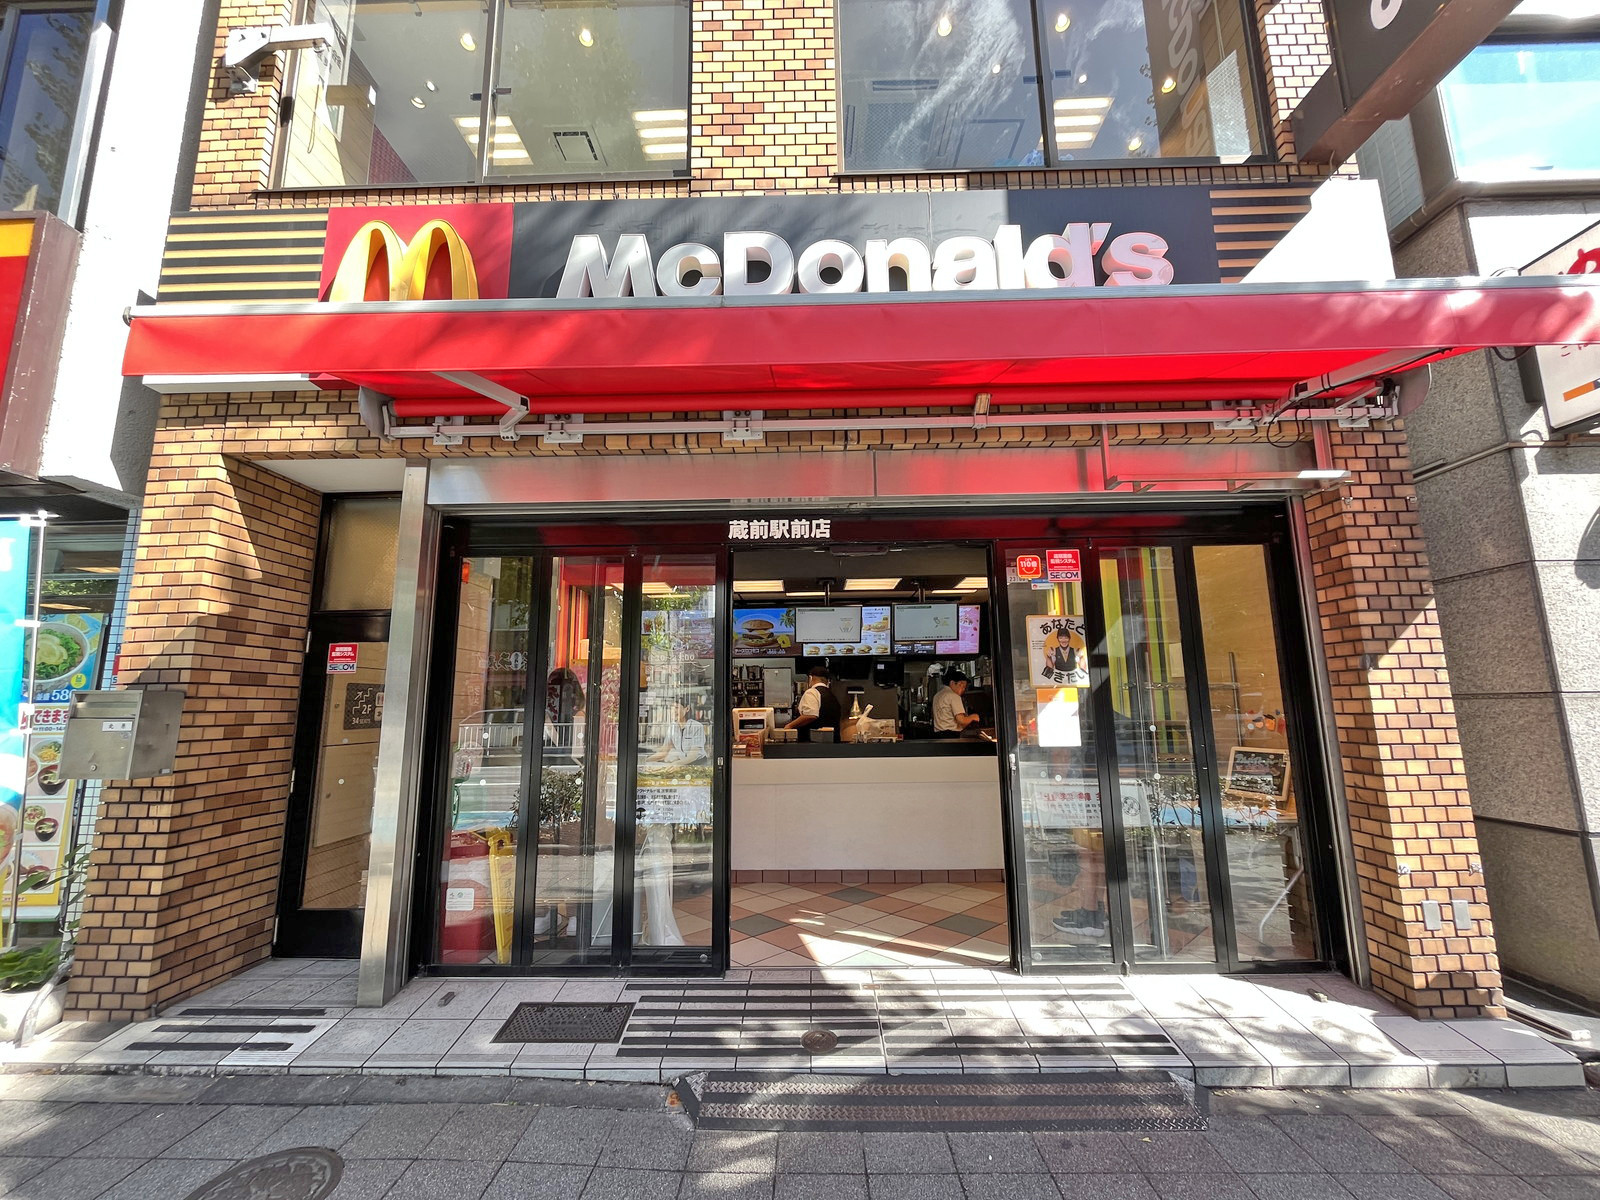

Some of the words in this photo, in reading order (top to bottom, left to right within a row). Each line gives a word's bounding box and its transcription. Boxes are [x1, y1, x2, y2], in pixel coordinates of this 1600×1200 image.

[556, 222, 1175, 298] McDonald's
[728, 518, 832, 540] 蔵前駅前店
[1050, 571, 1079, 579] SECOM
[1040, 618, 1086, 636] あなたと
[362, 704, 372, 714] 2F
